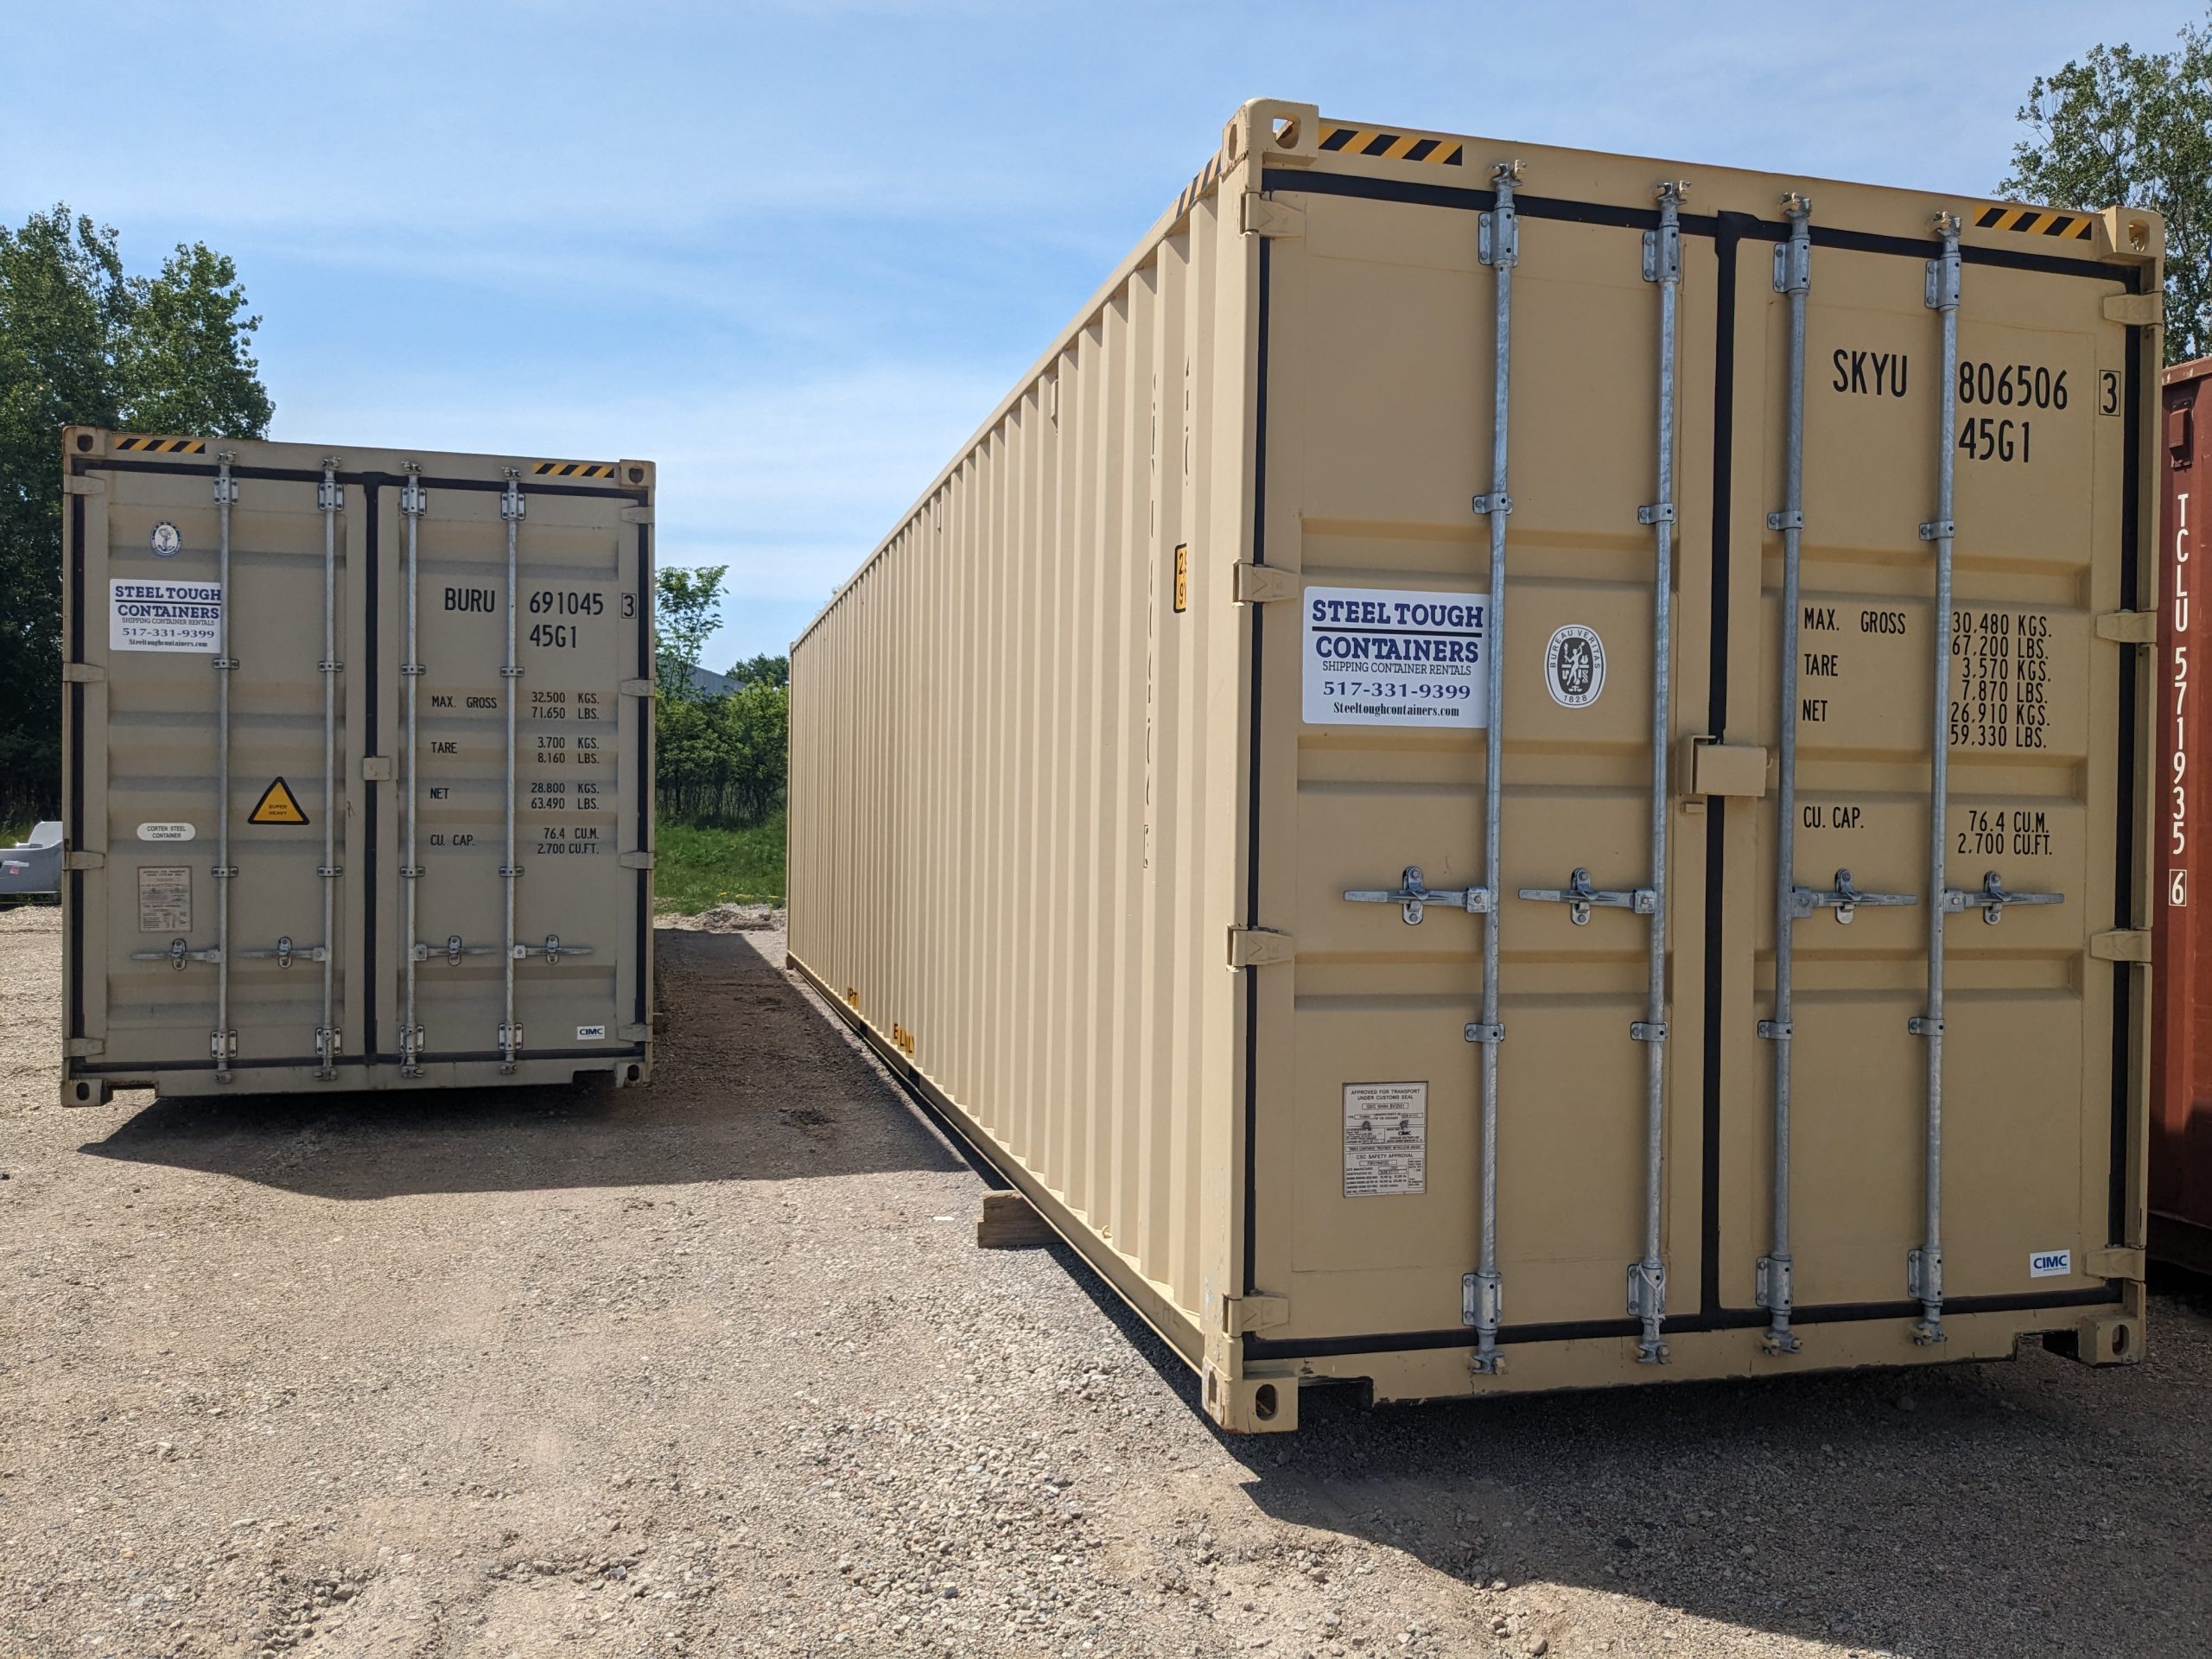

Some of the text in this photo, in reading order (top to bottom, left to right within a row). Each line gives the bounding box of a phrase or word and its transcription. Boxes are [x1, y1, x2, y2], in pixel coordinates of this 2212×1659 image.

[1832, 350, 2117, 412] SKYU 806506 3
[1959, 417, 2030, 463] 45G1
[116, 586, 222, 601] STEEL TOUGH
[445, 588, 634, 617] BURU 691045 3
[118, 605, 219, 619] CONTAINERS
[1312, 599, 1484, 627] STEEL TOUGH
[1804, 607, 2052, 638] MAX. GROSS 30,480 KGS.
[123, 627, 214, 638] 517-331-9399
[529, 624, 577, 649] 45G1
[129, 639, 208, 647] Steeltoughcontainers.com
[1316, 635, 1479, 664] CONTAINERS
[1549, 629, 1602, 671] BUREAU VERITAS
[1952, 635, 2049, 659] 67,200 LBS.
[1323, 661, 1471, 677] SHIPPING CONTAINER RENTALS
[1804, 653, 2051, 682] TARE 3,570 KGS.
[1323, 681, 1471, 700] 517-331-9399
[1563, 694, 1588, 703] 1828
[1961, 680, 2048, 704] 7,870 LBS.
[2171, 494, 2189, 903] TCLU 571935 6
[432, 696, 456, 709] MAX.
[467, 696, 498, 709] GROSS
[578, 693, 600, 704] KGS.
[1333, 702, 1460, 718] Steeltoughcontainers.com
[578, 708, 600, 720] LBS.
[1802, 699, 2050, 727] NET 26,910 KGS.
[1950, 724, 2047, 748] 59,330 LBS.
[430, 742, 458, 754] TARE
[578, 738, 600, 749] KGS.
[578, 753, 600, 765] LBS.
[430, 788, 449, 799] NET
[577, 783, 600, 794] KGS.
[577, 798, 600, 810] LBS.
[1803, 806, 2049, 833] CU. CAP. 76.4 CU.M.
[430, 828, 600, 847] CU. CAP. 76.4 CU.M.
[1958, 832, 2052, 855] 2,700 CU.FT.
[569, 842, 600, 855] CU.FT.
[2033, 1255, 2068, 1269] CIMC
